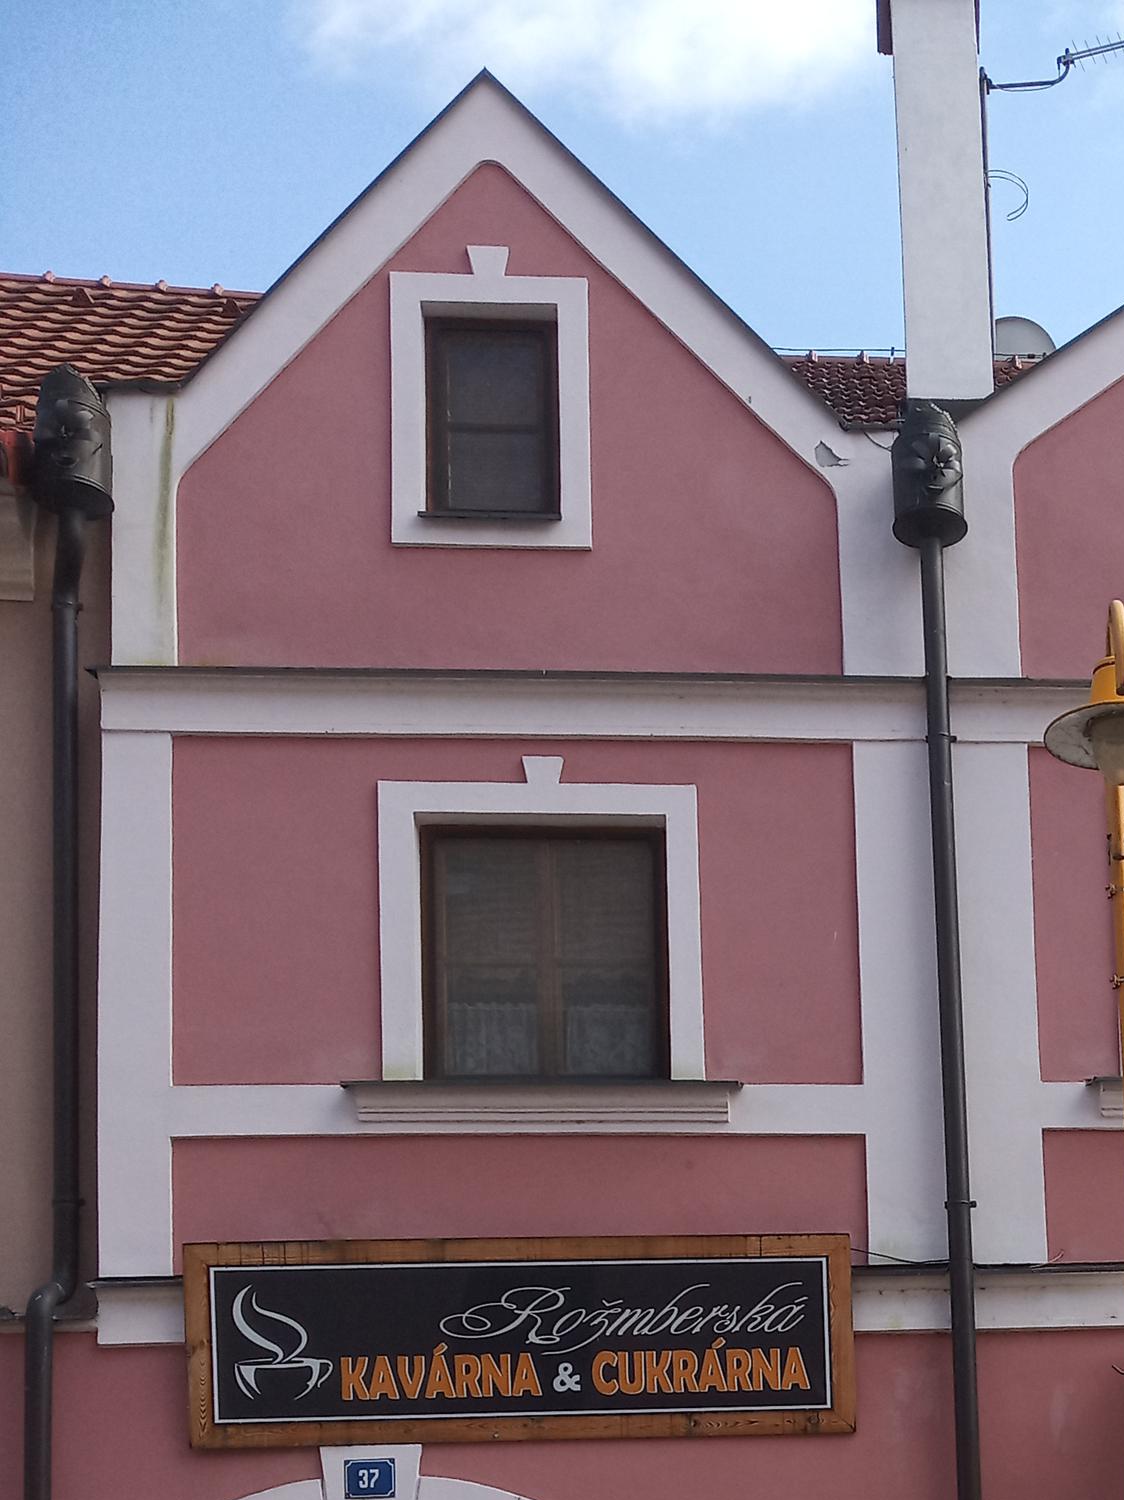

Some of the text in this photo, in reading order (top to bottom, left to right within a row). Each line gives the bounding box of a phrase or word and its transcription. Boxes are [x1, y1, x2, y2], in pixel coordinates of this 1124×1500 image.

[439, 1281, 808, 1356] Rožmberská
[340, 1337, 811, 1401] KAVÁRNA & CUKRÁRNA
[357, 1468, 380, 1490] 37
